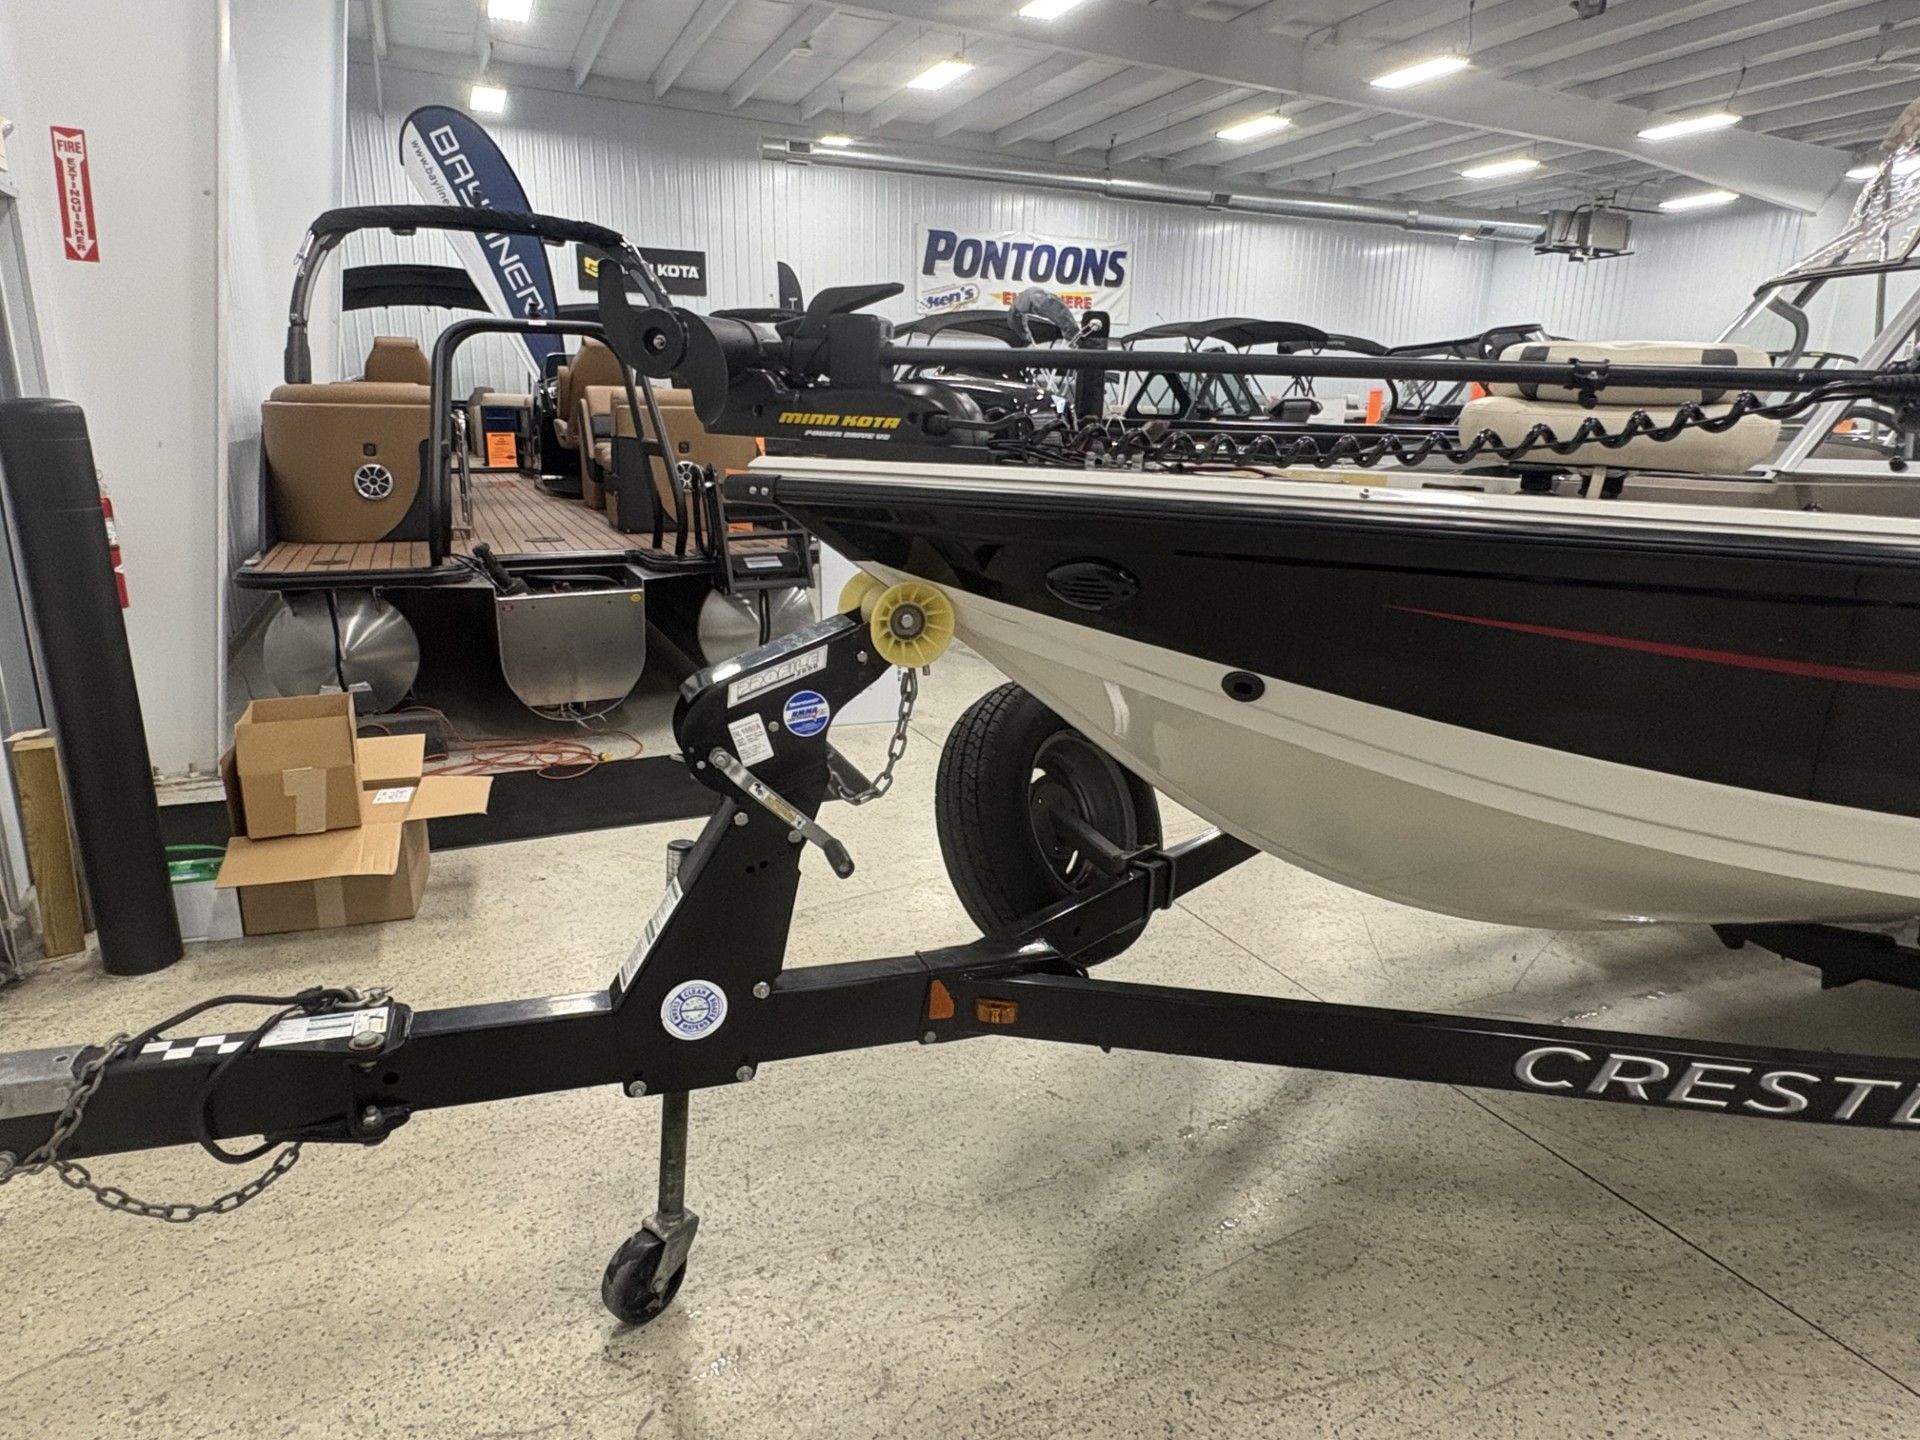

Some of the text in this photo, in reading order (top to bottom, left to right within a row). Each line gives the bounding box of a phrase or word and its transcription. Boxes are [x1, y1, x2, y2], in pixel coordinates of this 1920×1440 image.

[56, 139, 82, 154] FIRE
[410, 138, 450, 205] www.bayline
[66, 157, 86, 252] EXTINGUISHER
[428, 124, 546, 316] BAYINER
[922, 228, 1127, 288] PONTOONS
[657, 263, 700, 279] KOTA
[778, 412, 901, 429] MINN KOTA
[804, 429, 843, 437] POWER
[737, 650, 821, 698] PROFILE
[683, 988, 707, 998] CLEAN
[682, 1021, 709, 1030] WATERS
